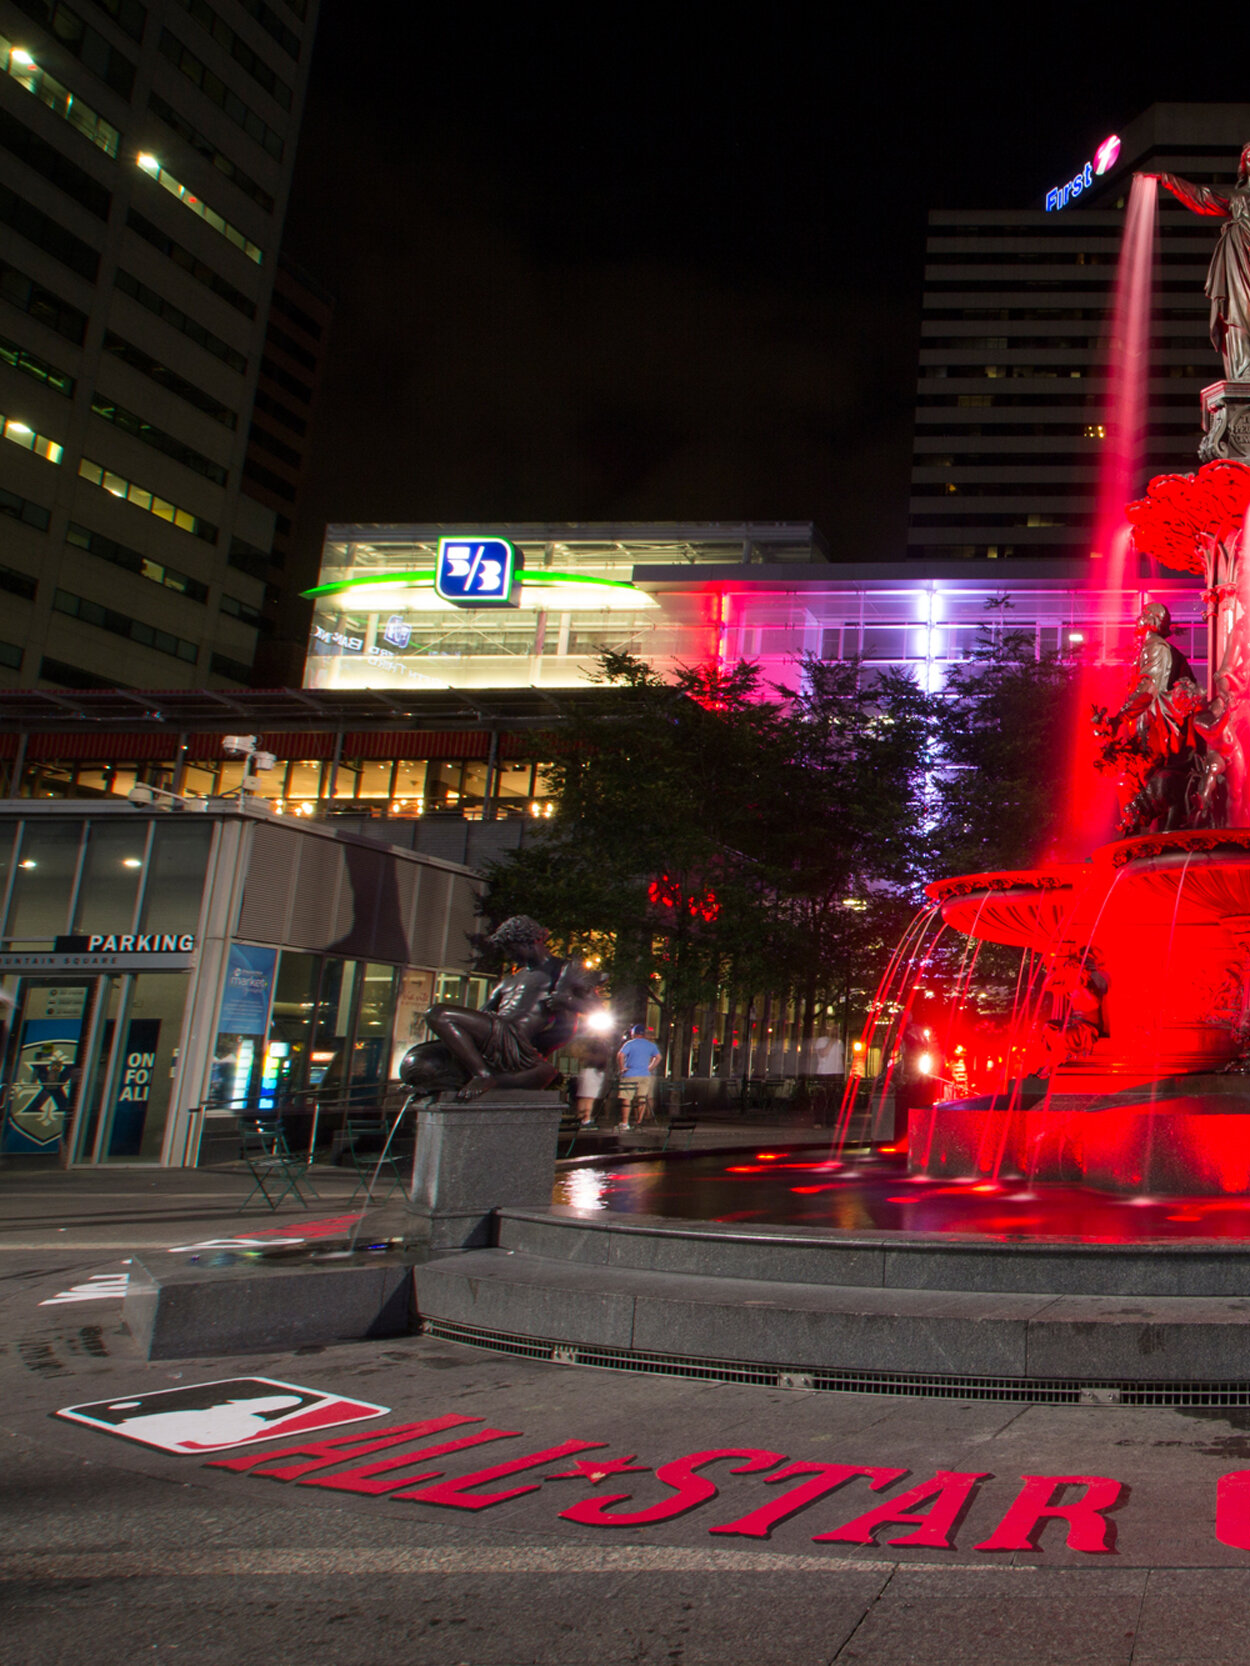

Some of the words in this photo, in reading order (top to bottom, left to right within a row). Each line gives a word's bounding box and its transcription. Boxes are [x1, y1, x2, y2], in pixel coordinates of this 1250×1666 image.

[1045, 161, 1093, 212] First
[87, 934, 195, 952] PARKING
[0, 956, 56, 966] UNTAIN
[64, 956, 119, 965] SQUARE
[203, 1412, 609, 1511] ALL
[557, 1447, 1120, 1555] STAR
